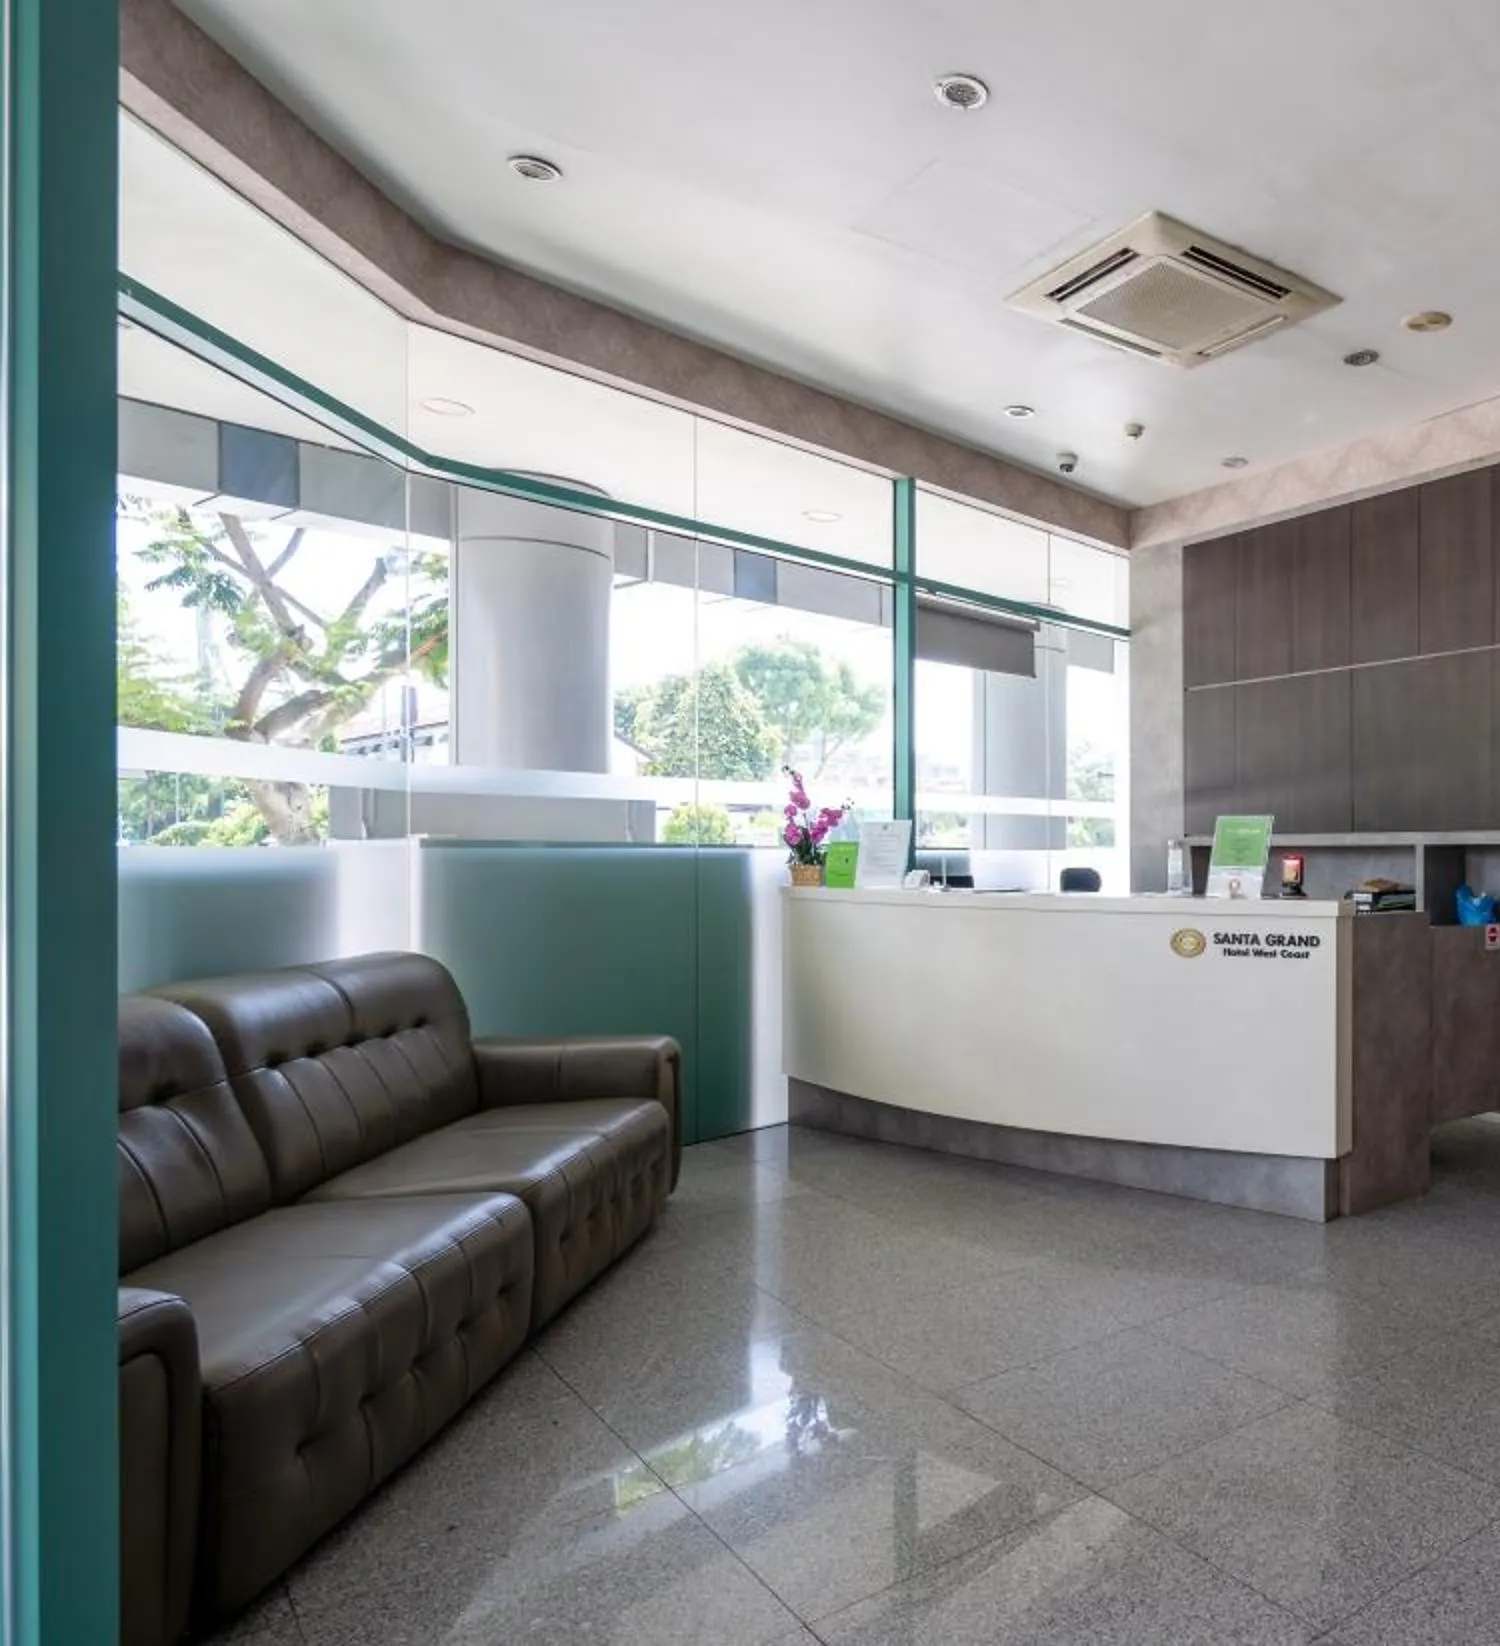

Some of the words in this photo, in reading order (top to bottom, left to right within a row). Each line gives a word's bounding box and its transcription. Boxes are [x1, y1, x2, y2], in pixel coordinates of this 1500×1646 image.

[1213, 932, 1260, 946] SANTA
[1265, 934, 1321, 948] GRAND
[1223, 947, 1249, 957] Hotel
[1252, 949, 1277, 958] West
[1280, 950, 1310, 959] Coast
